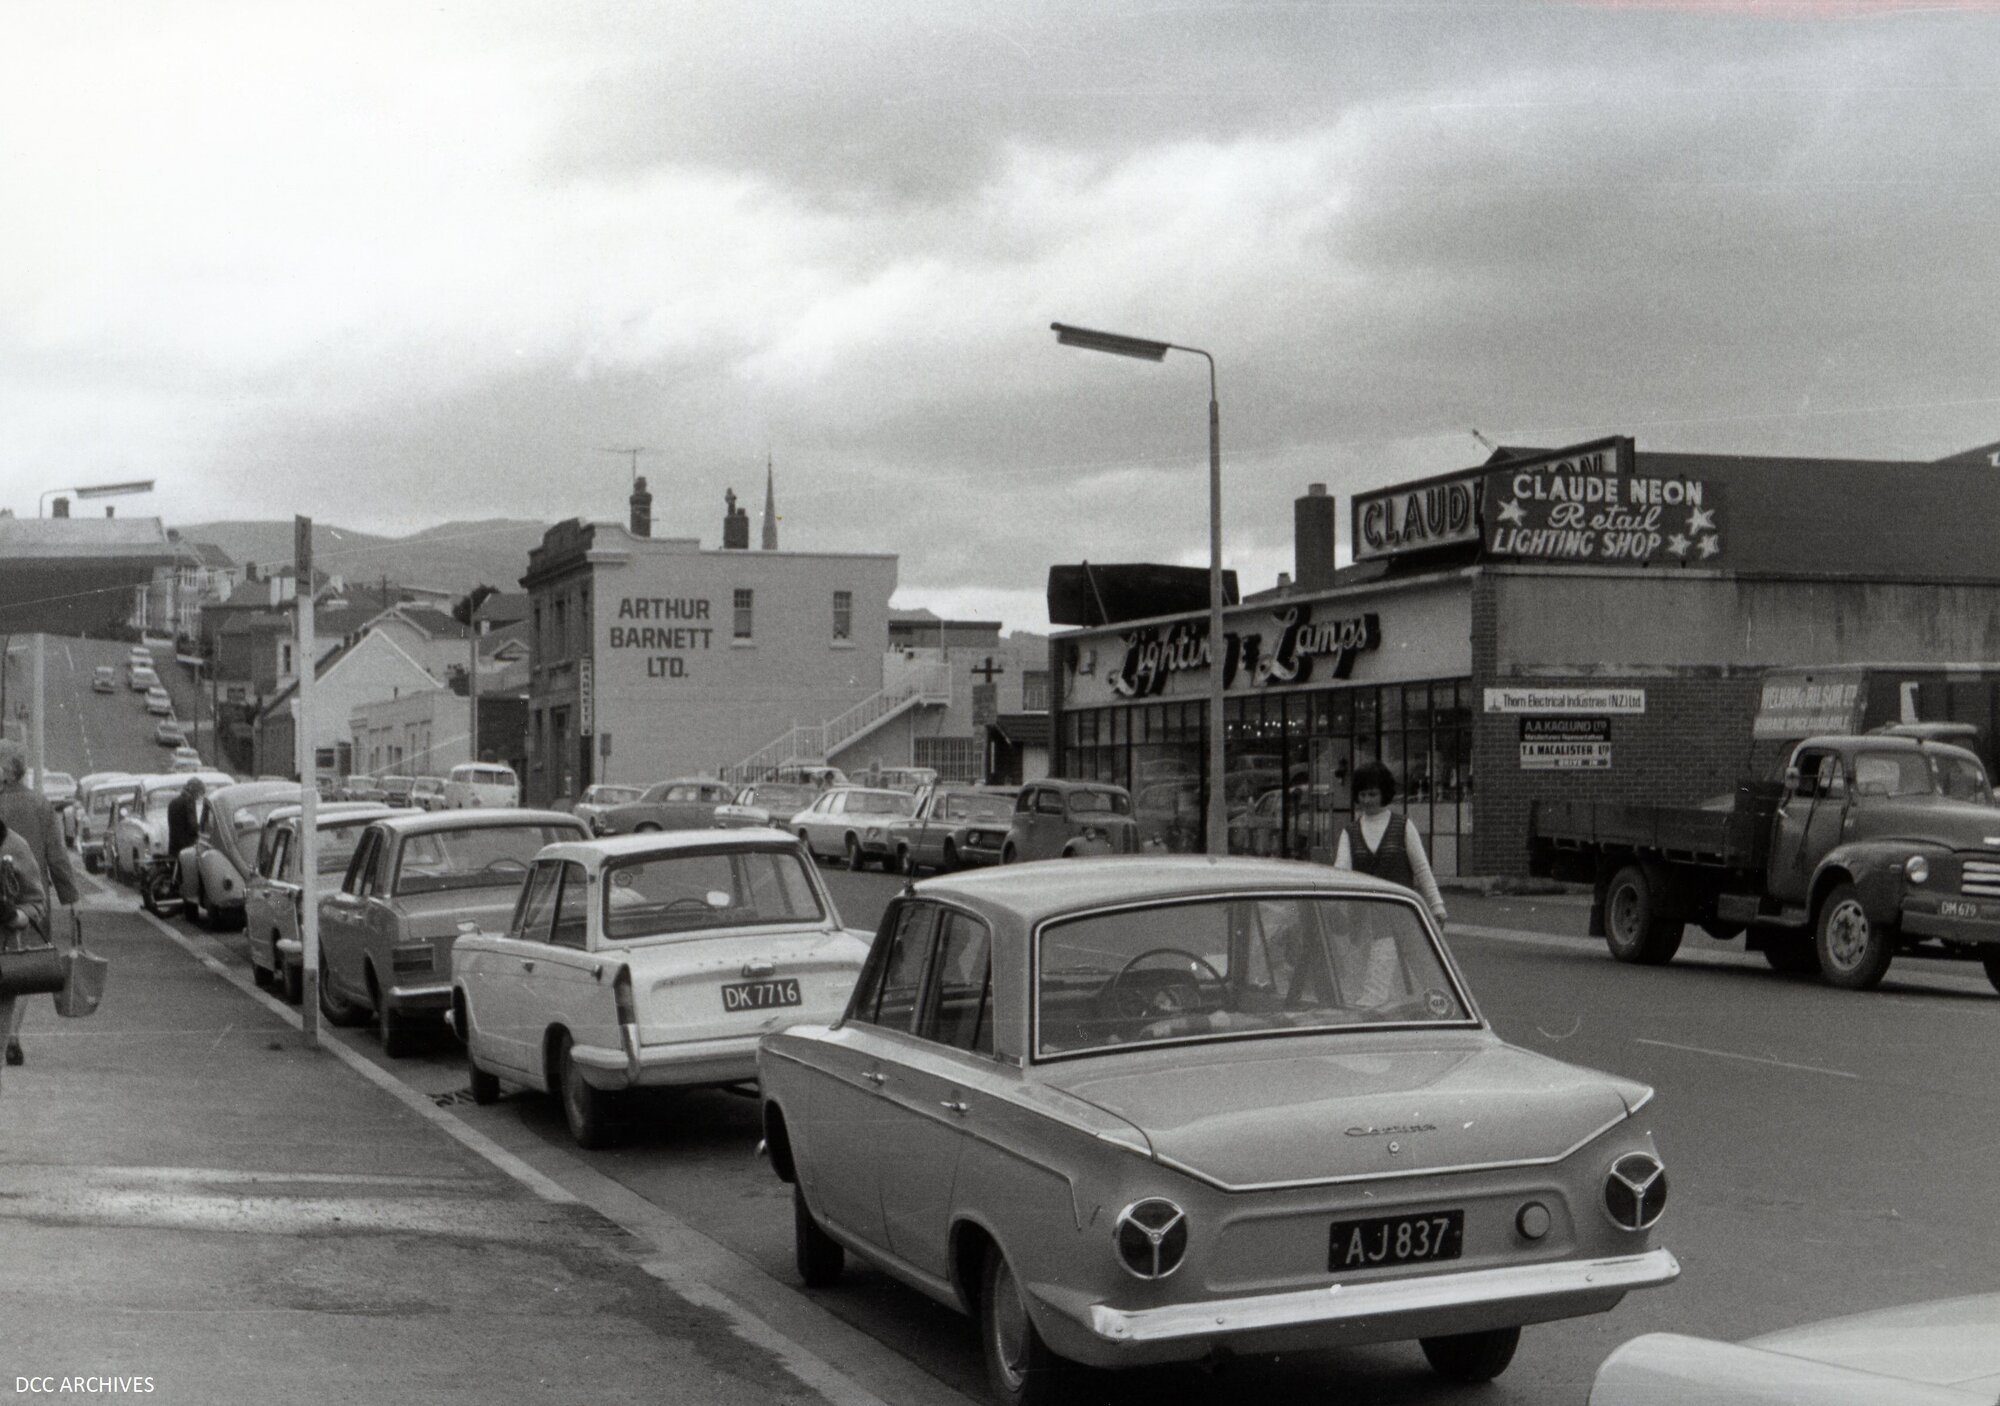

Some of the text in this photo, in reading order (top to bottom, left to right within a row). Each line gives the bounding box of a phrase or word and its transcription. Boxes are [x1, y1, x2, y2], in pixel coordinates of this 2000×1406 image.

[1513, 474, 1702, 506] CLAUDE NEON
[1549, 502, 1662, 532] Retail
[1492, 527, 1662, 559] LIGHTING SHOP
[618, 598, 710, 620] ARTHUR
[610, 627, 713, 649] BARNETT
[1106, 624, 1229, 697] Lightin
[1252, 606, 1367, 689] Lamps
[647, 657, 690, 678] LTD.
[1503, 694, 1526, 708] Thorn
[1528, 694, 1566, 708] Electrical
[1567, 694, 1607, 708] Industries
